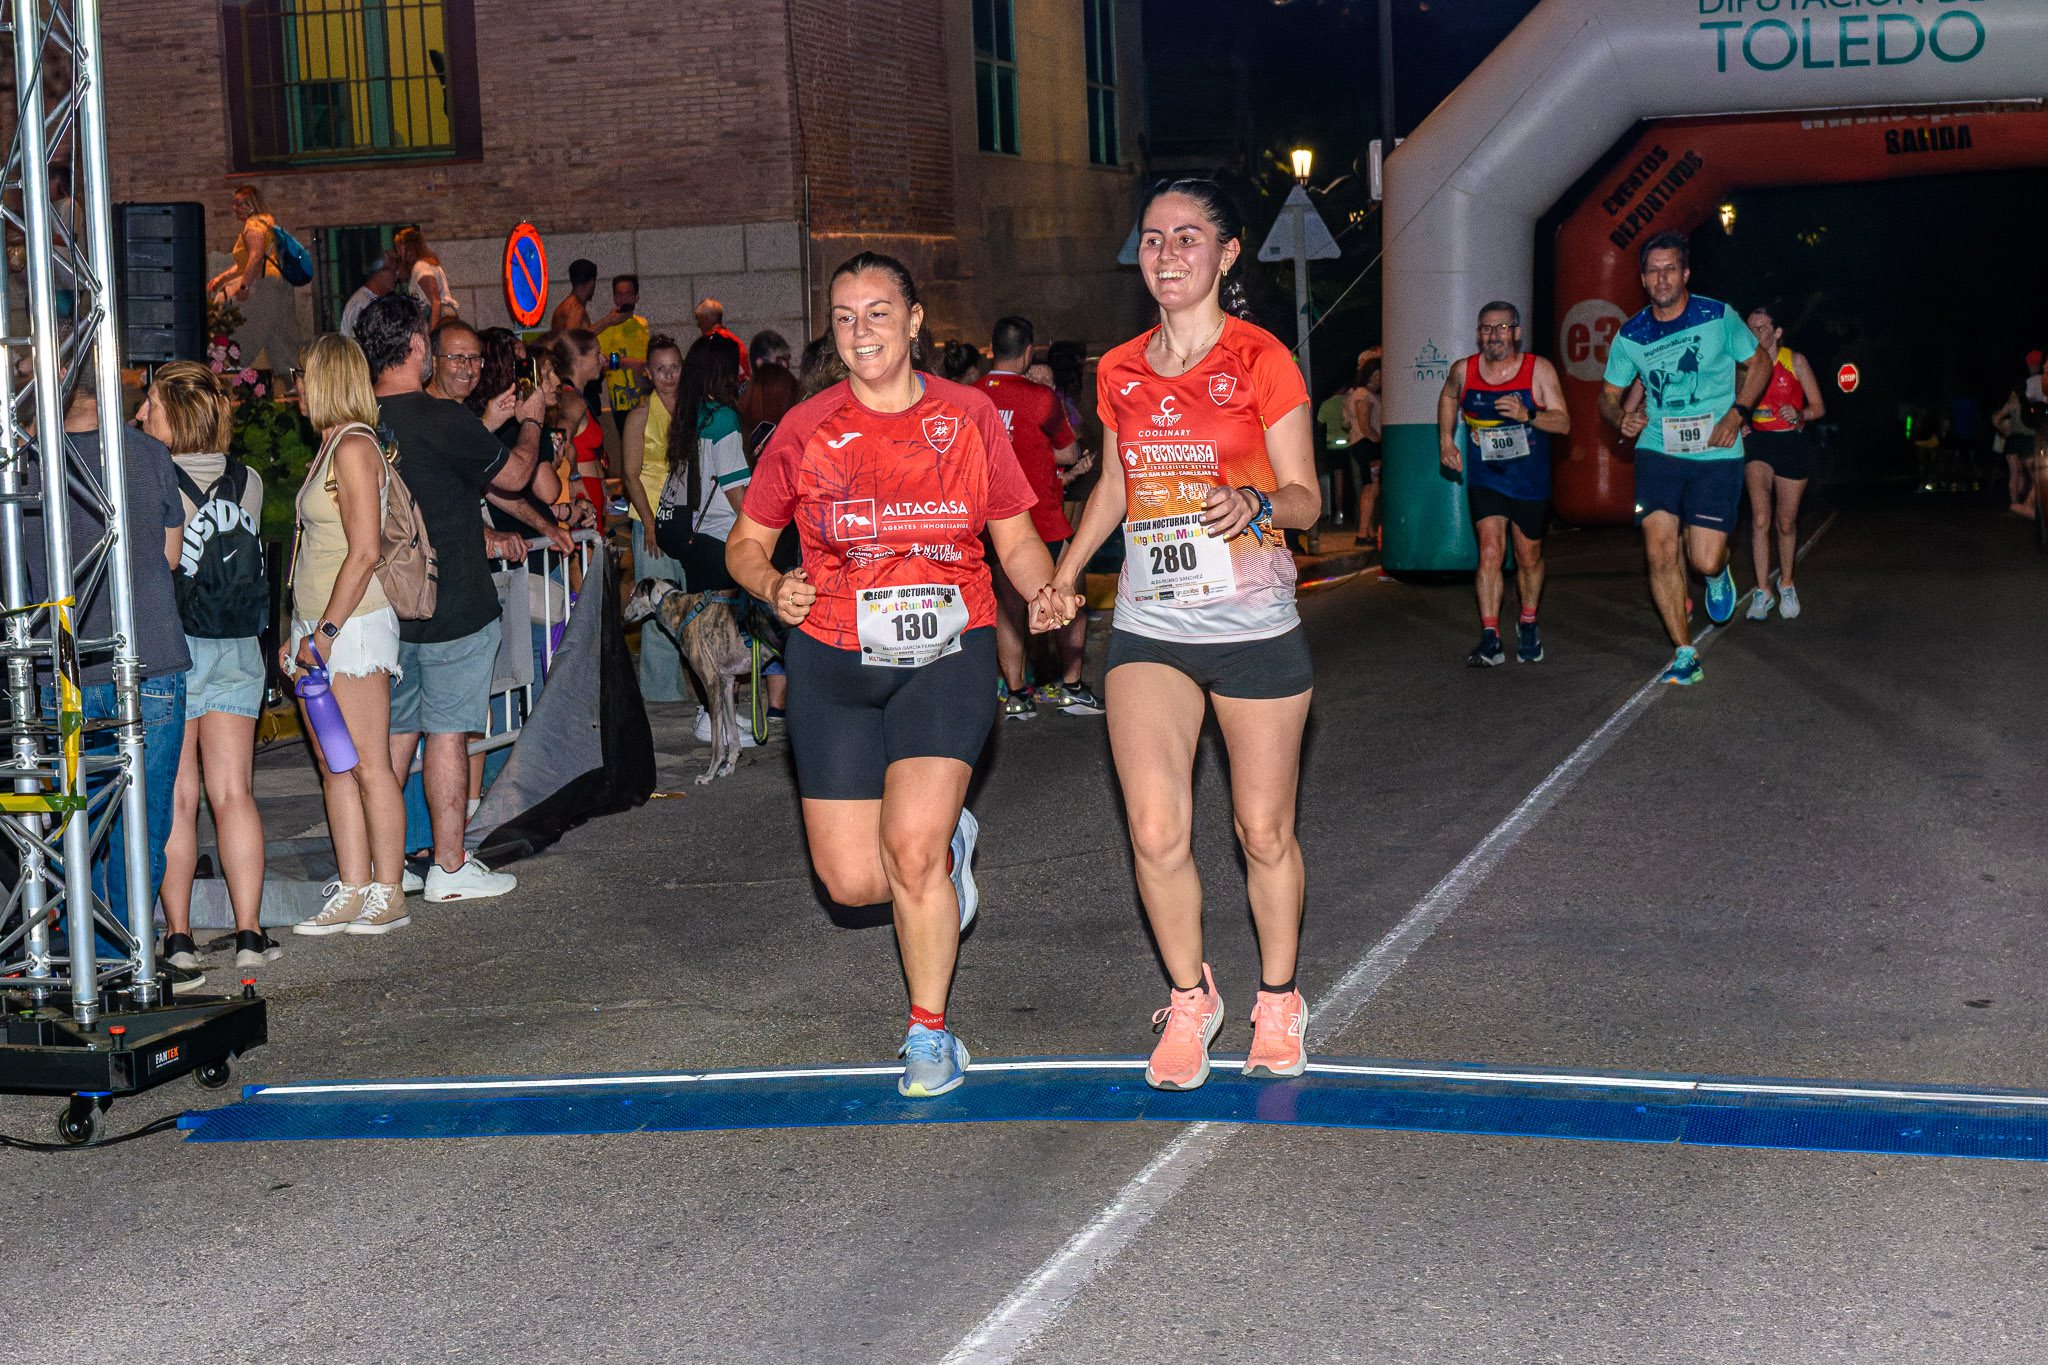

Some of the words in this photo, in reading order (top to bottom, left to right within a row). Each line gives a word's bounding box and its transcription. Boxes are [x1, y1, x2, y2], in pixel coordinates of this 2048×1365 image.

[1700, 10, 1985, 73] TOLEDO
[1885, 125, 1973, 155] SALIDA
[1602, 144, 1669, 216] EVENTOS
[1609, 149, 1704, 251] DEPORTIVOS
[1840, 373, 1856, 383] STOP
[1138, 429, 1191, 437] COOLINARY
[1678, 427, 1701, 442] 199
[1491, 437, 1513, 449] 300
[1142, 444, 1214, 463] TECNOCASA
[881, 500, 968, 517] ALTACASA
[1133, 523, 1151, 532] LEGUA
[1152, 515, 1190, 530] NOCTURNA
[179, 500, 218, 577] JUST
[923, 543, 955, 554] NUTRI
[924, 551, 963, 562] LAVERIA
[1150, 542, 1197, 575] 280
[891, 611, 938, 641] 130
[155, 1046, 180, 1065] FANTEK
